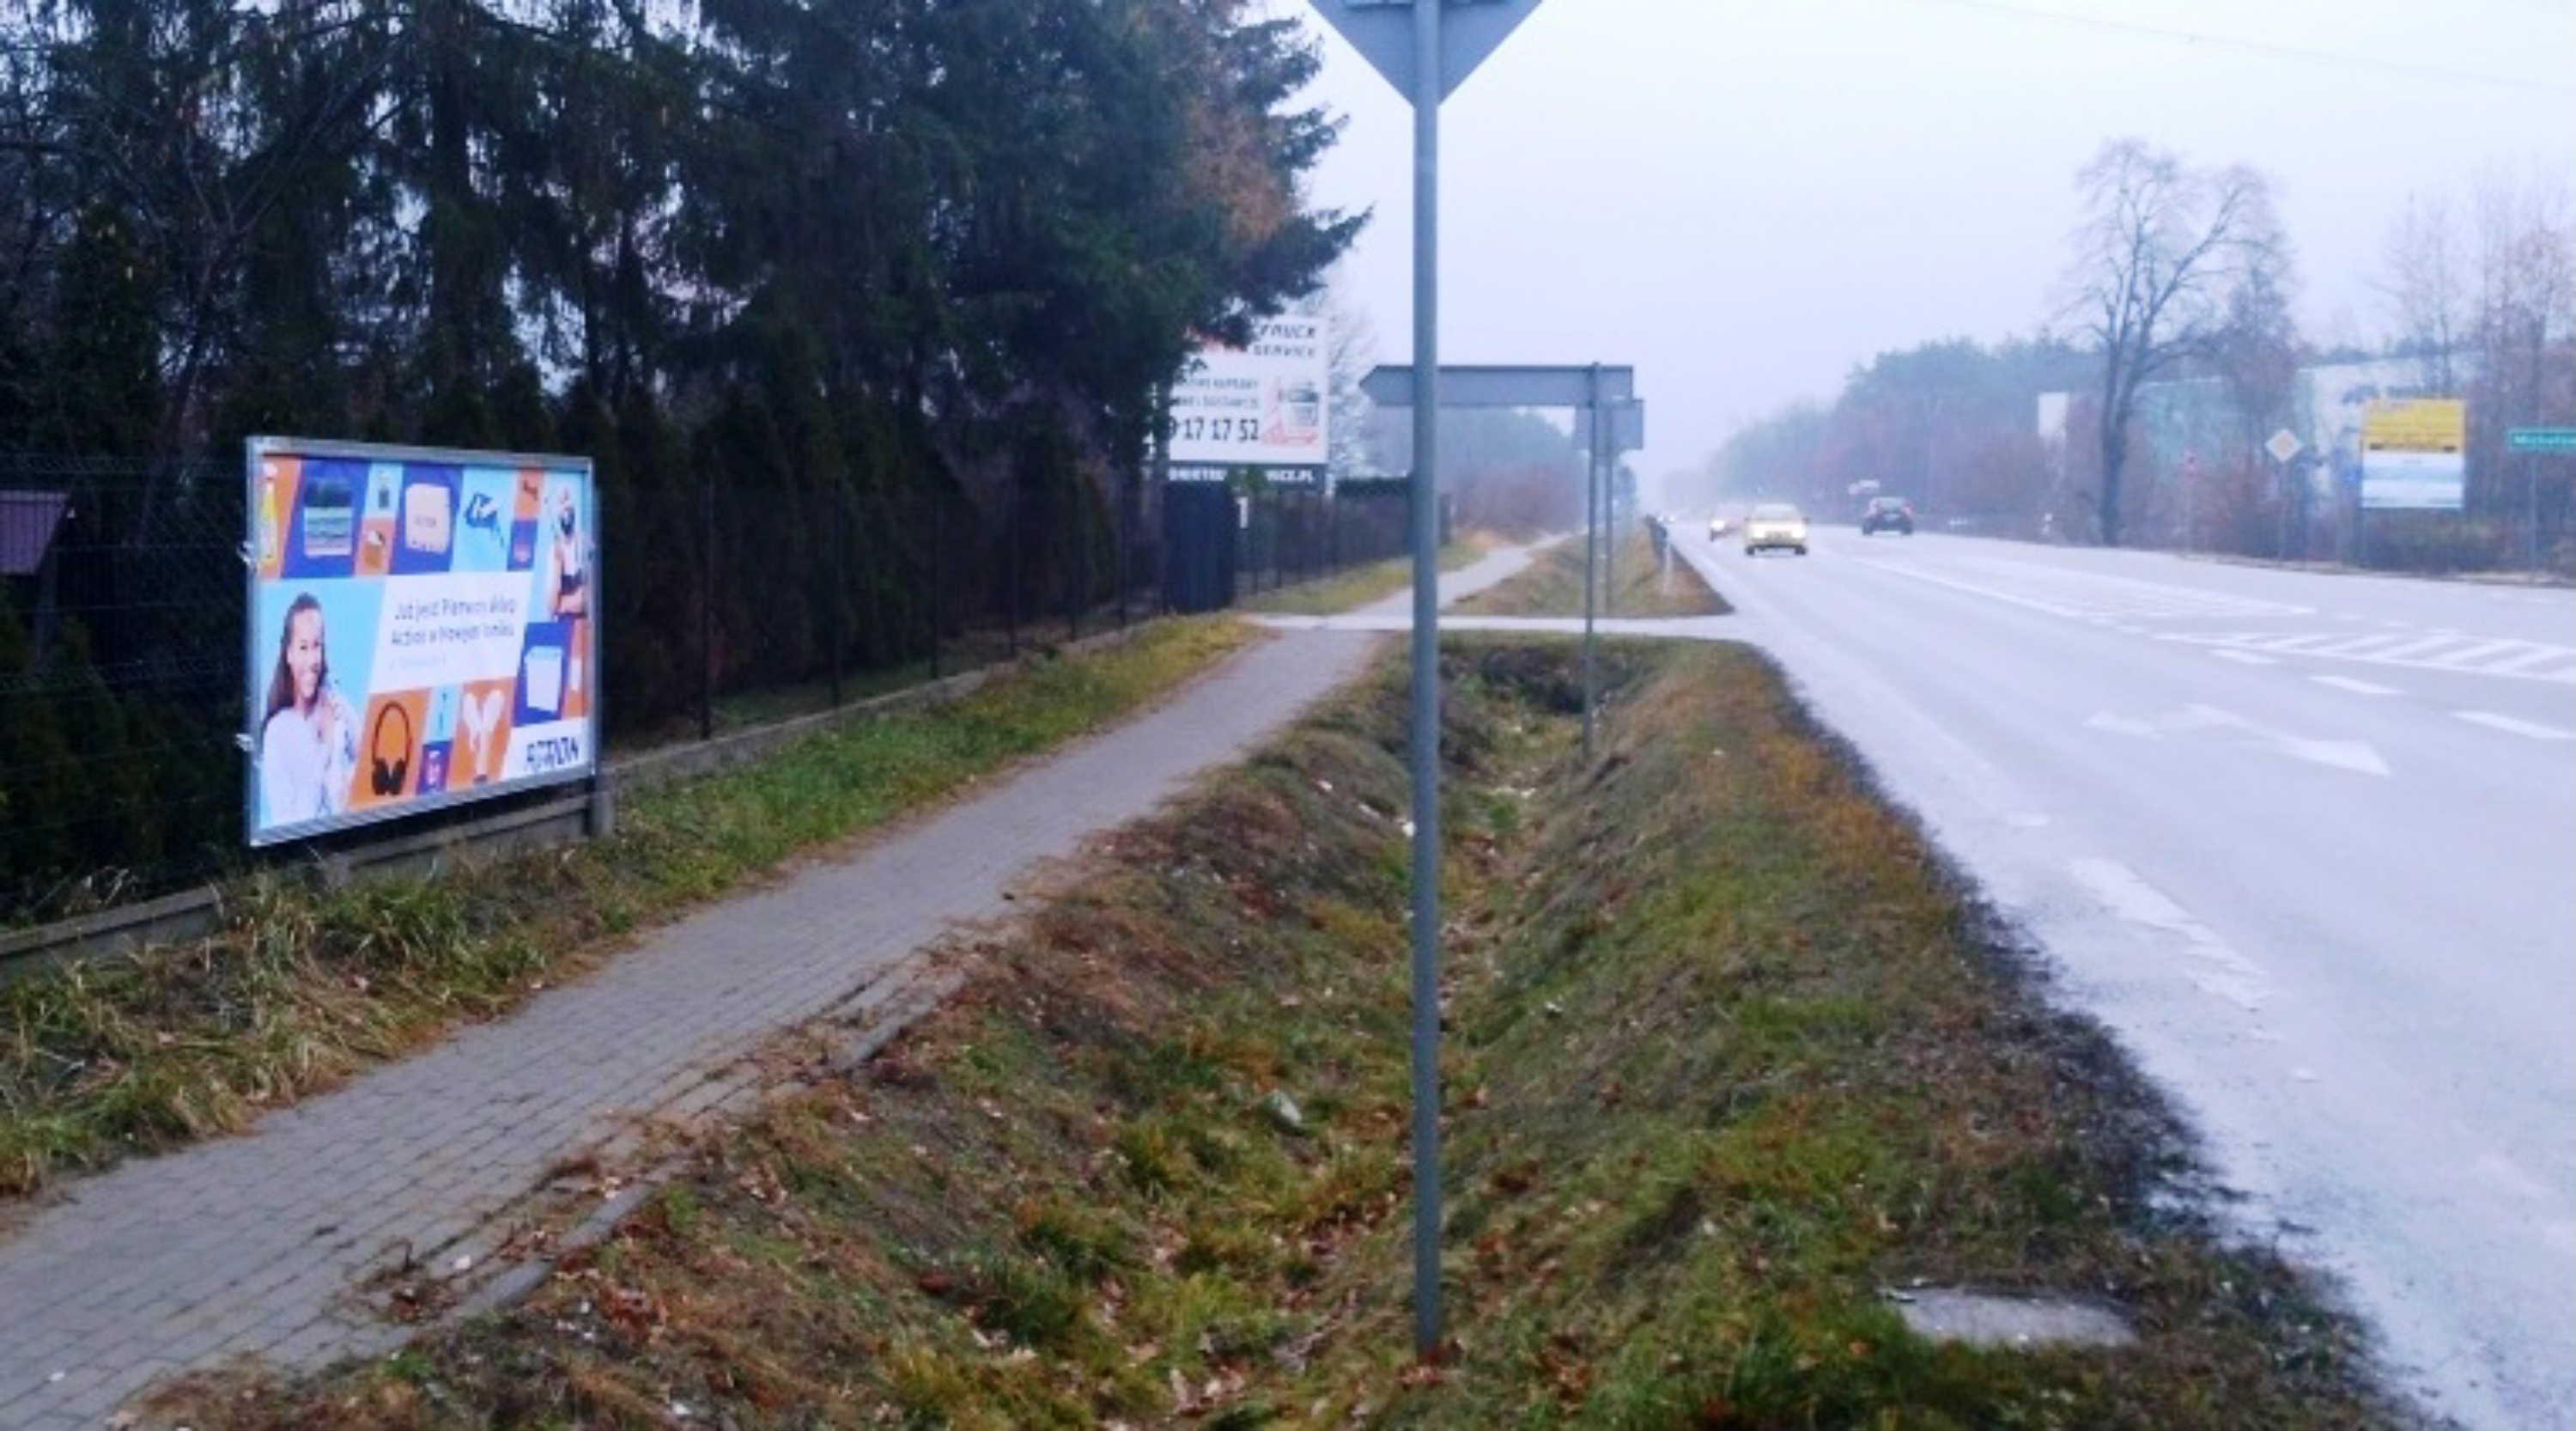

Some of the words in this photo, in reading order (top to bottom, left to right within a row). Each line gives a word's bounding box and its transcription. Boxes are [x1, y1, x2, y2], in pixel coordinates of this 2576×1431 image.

[1184, 417, 1205, 441] 17
[1212, 417, 1232, 441] 17
[1238, 417, 1259, 442] 52
